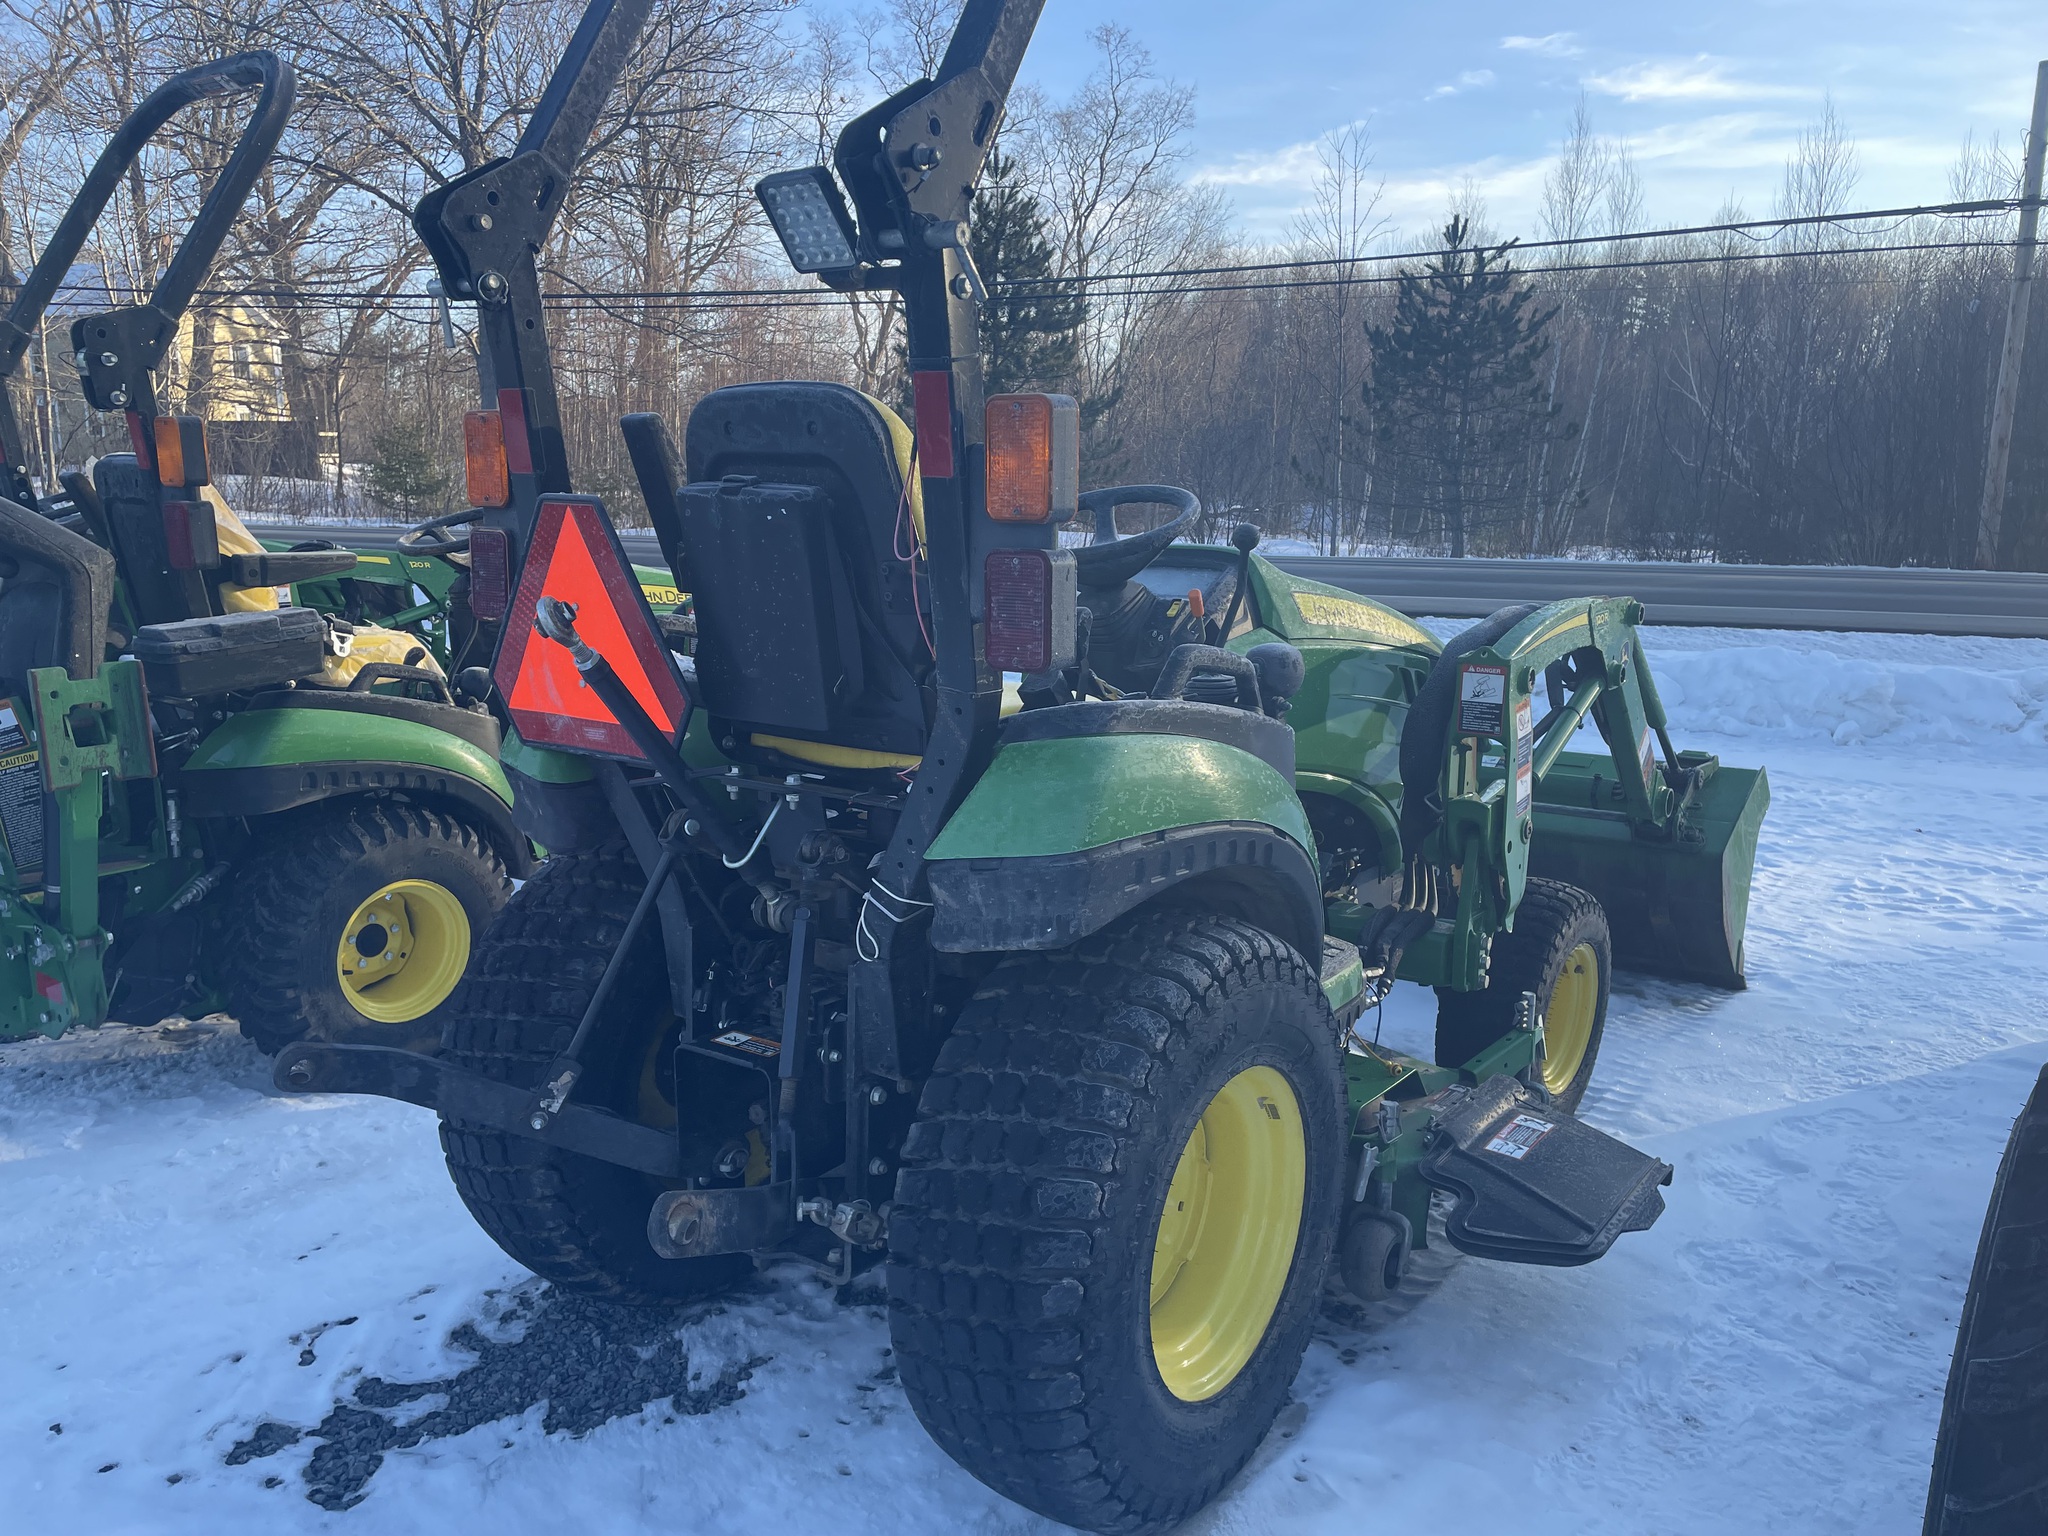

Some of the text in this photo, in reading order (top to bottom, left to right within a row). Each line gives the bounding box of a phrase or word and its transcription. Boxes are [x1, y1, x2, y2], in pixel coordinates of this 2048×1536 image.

[409, 561, 424, 569] 120
[645, 592, 664, 602] HN
[0, 752, 35, 768] CAUTION
